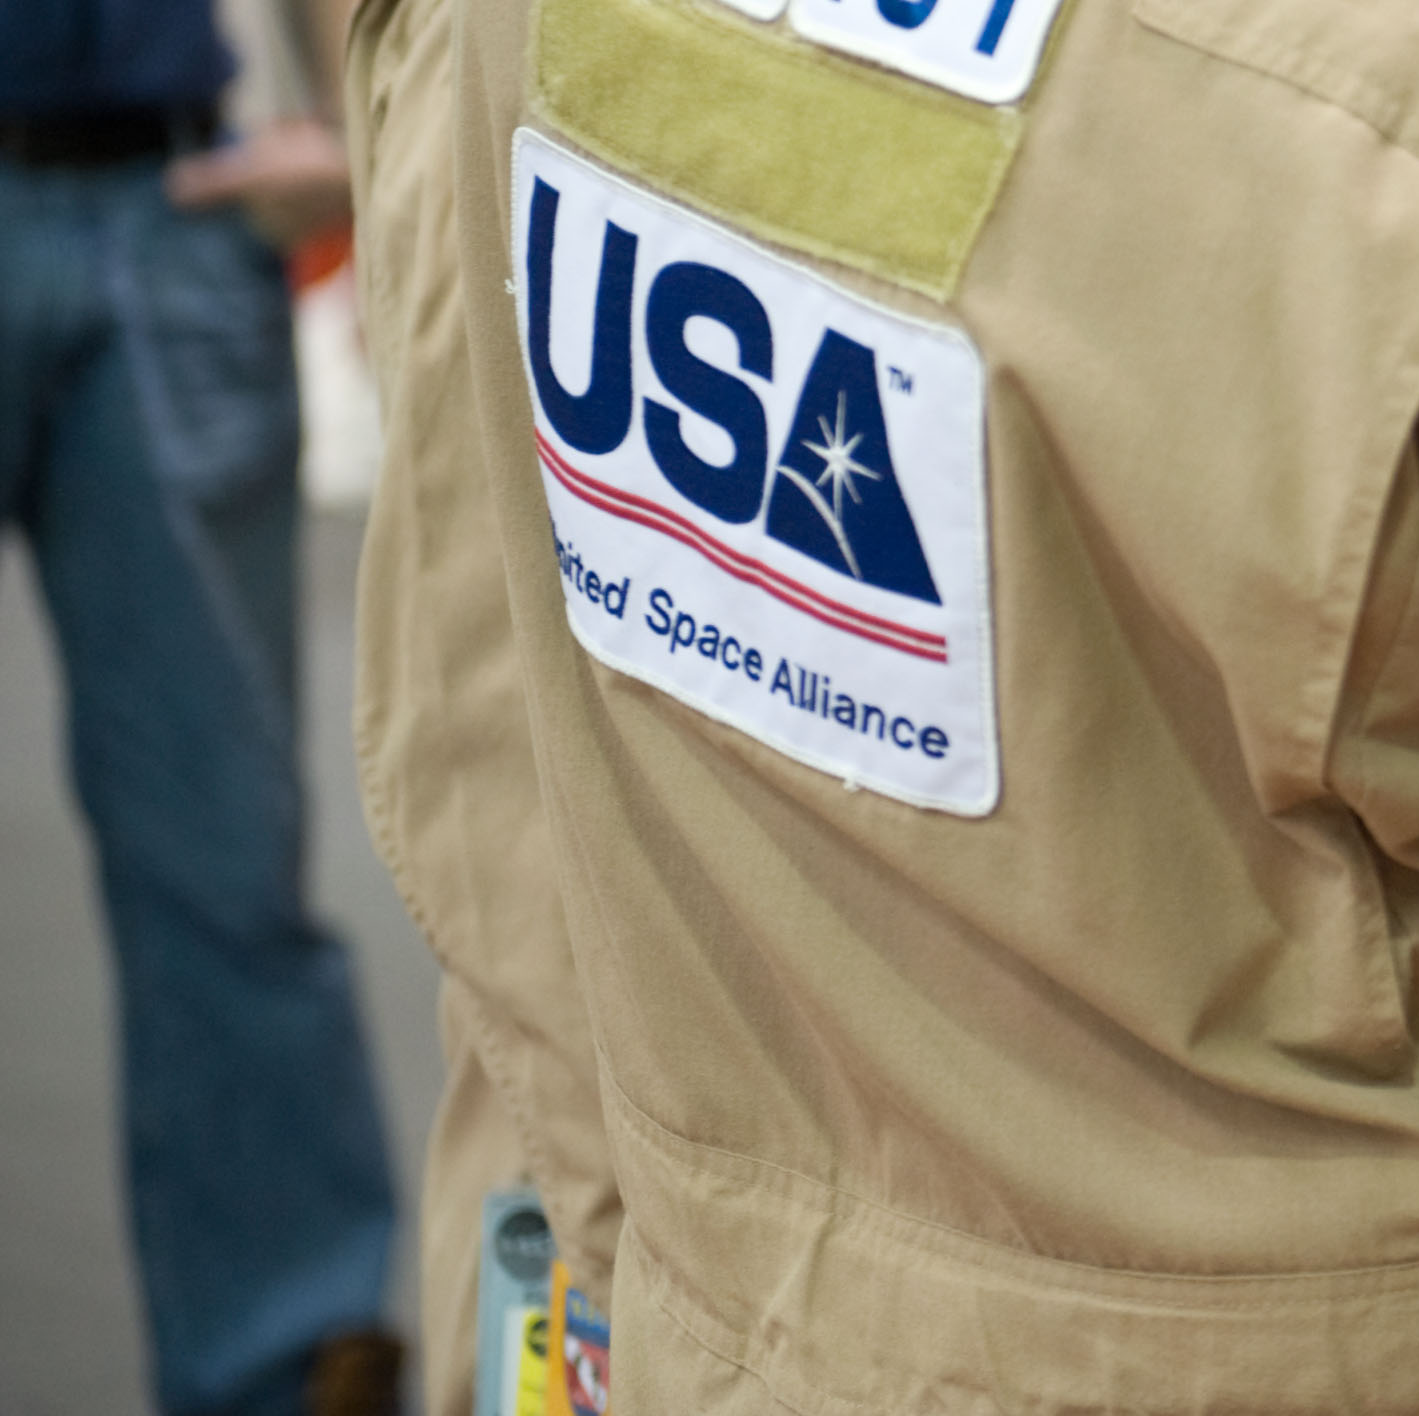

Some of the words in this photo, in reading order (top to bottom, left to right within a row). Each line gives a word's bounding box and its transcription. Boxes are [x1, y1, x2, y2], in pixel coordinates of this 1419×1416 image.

[527, 174, 943, 606] USA
[550, 516, 631, 621] nited
[644, 587, 764, 683] Space
[770, 658, 950, 760] Alliance
